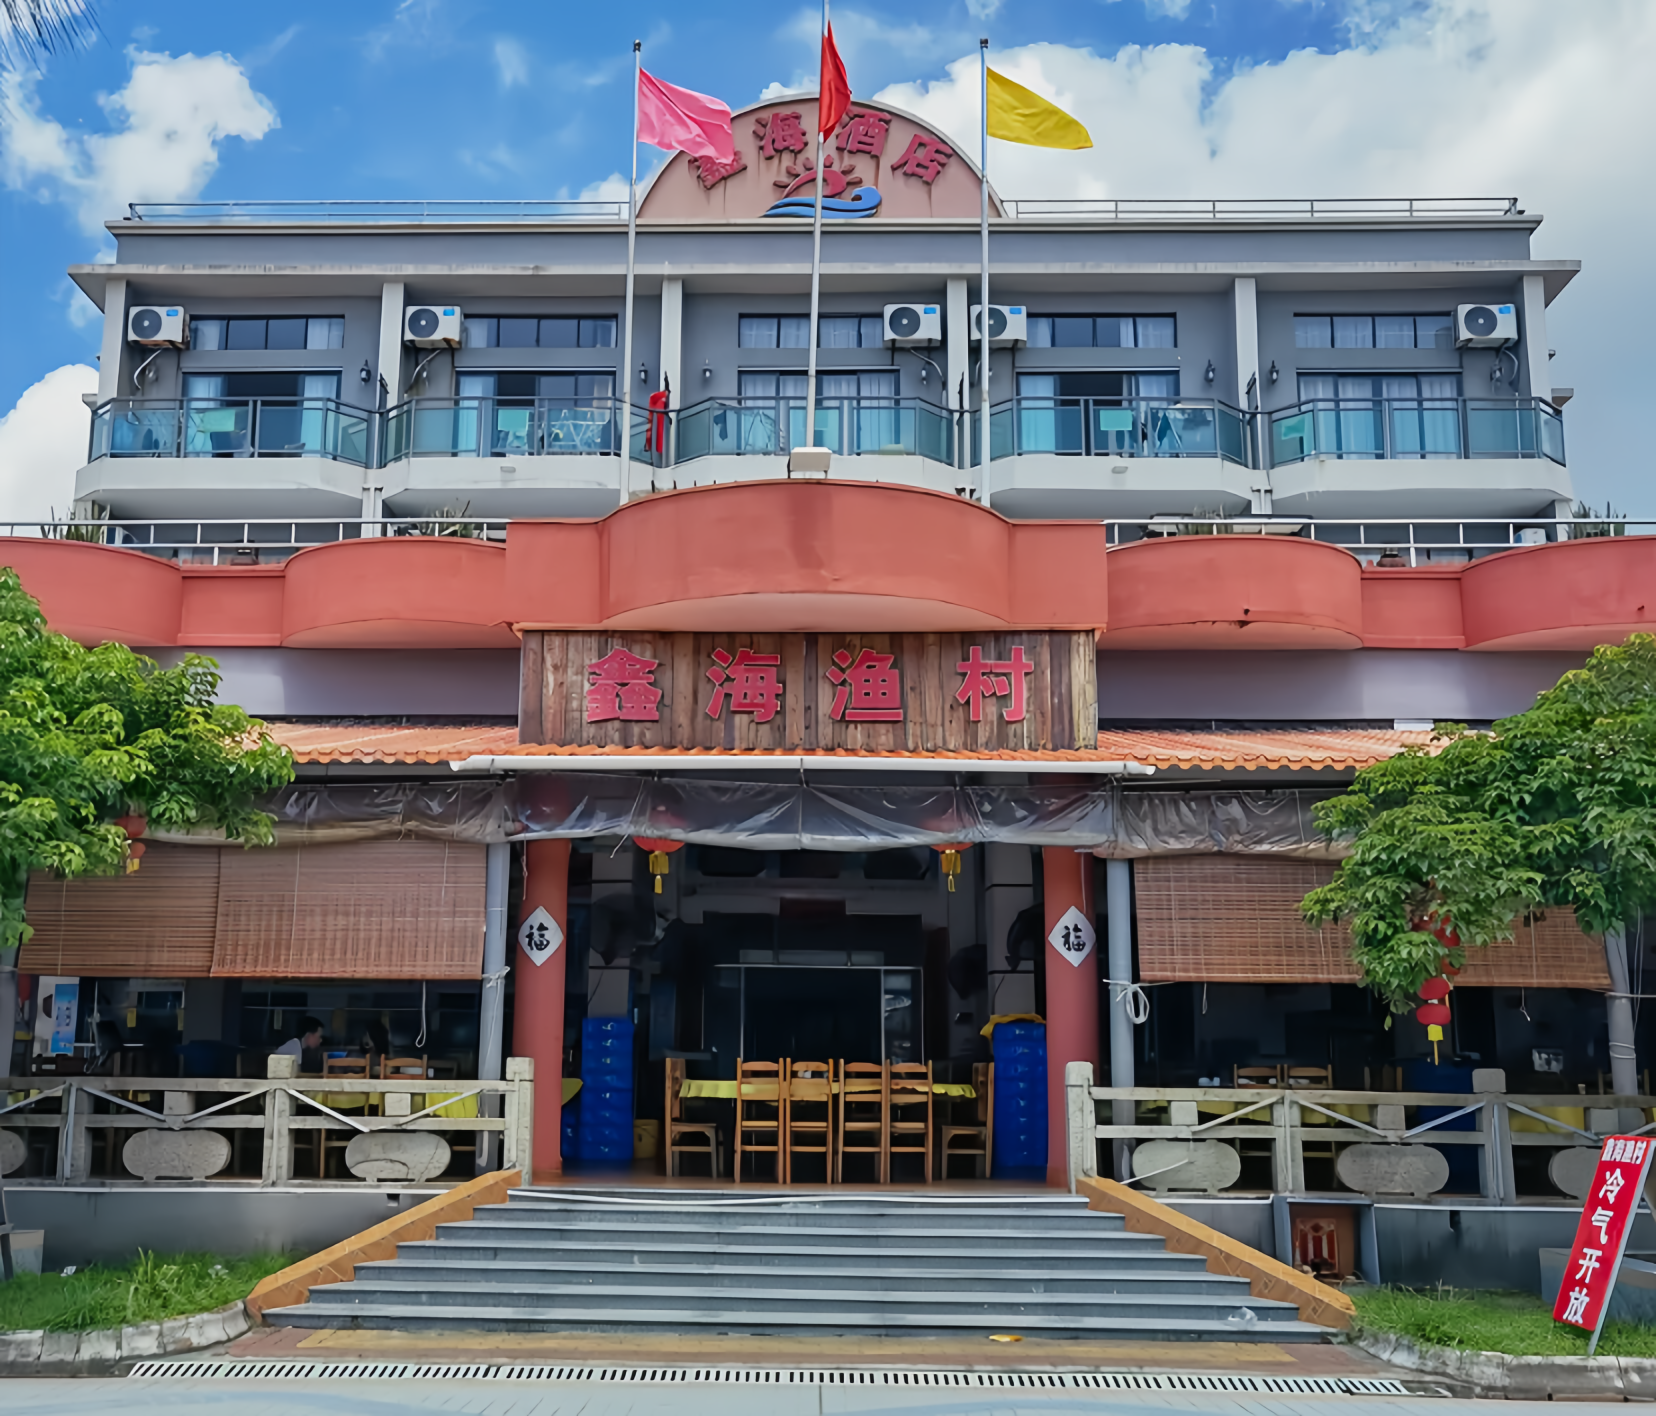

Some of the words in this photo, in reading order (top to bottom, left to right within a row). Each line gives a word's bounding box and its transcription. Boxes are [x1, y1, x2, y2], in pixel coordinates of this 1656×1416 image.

[586, 646, 1034, 723] 鑫海渔村
[525, 922, 551, 952] 福
[1061, 923, 1087, 952] 福
[1562, 1168, 1625, 1325] 冷气开放
